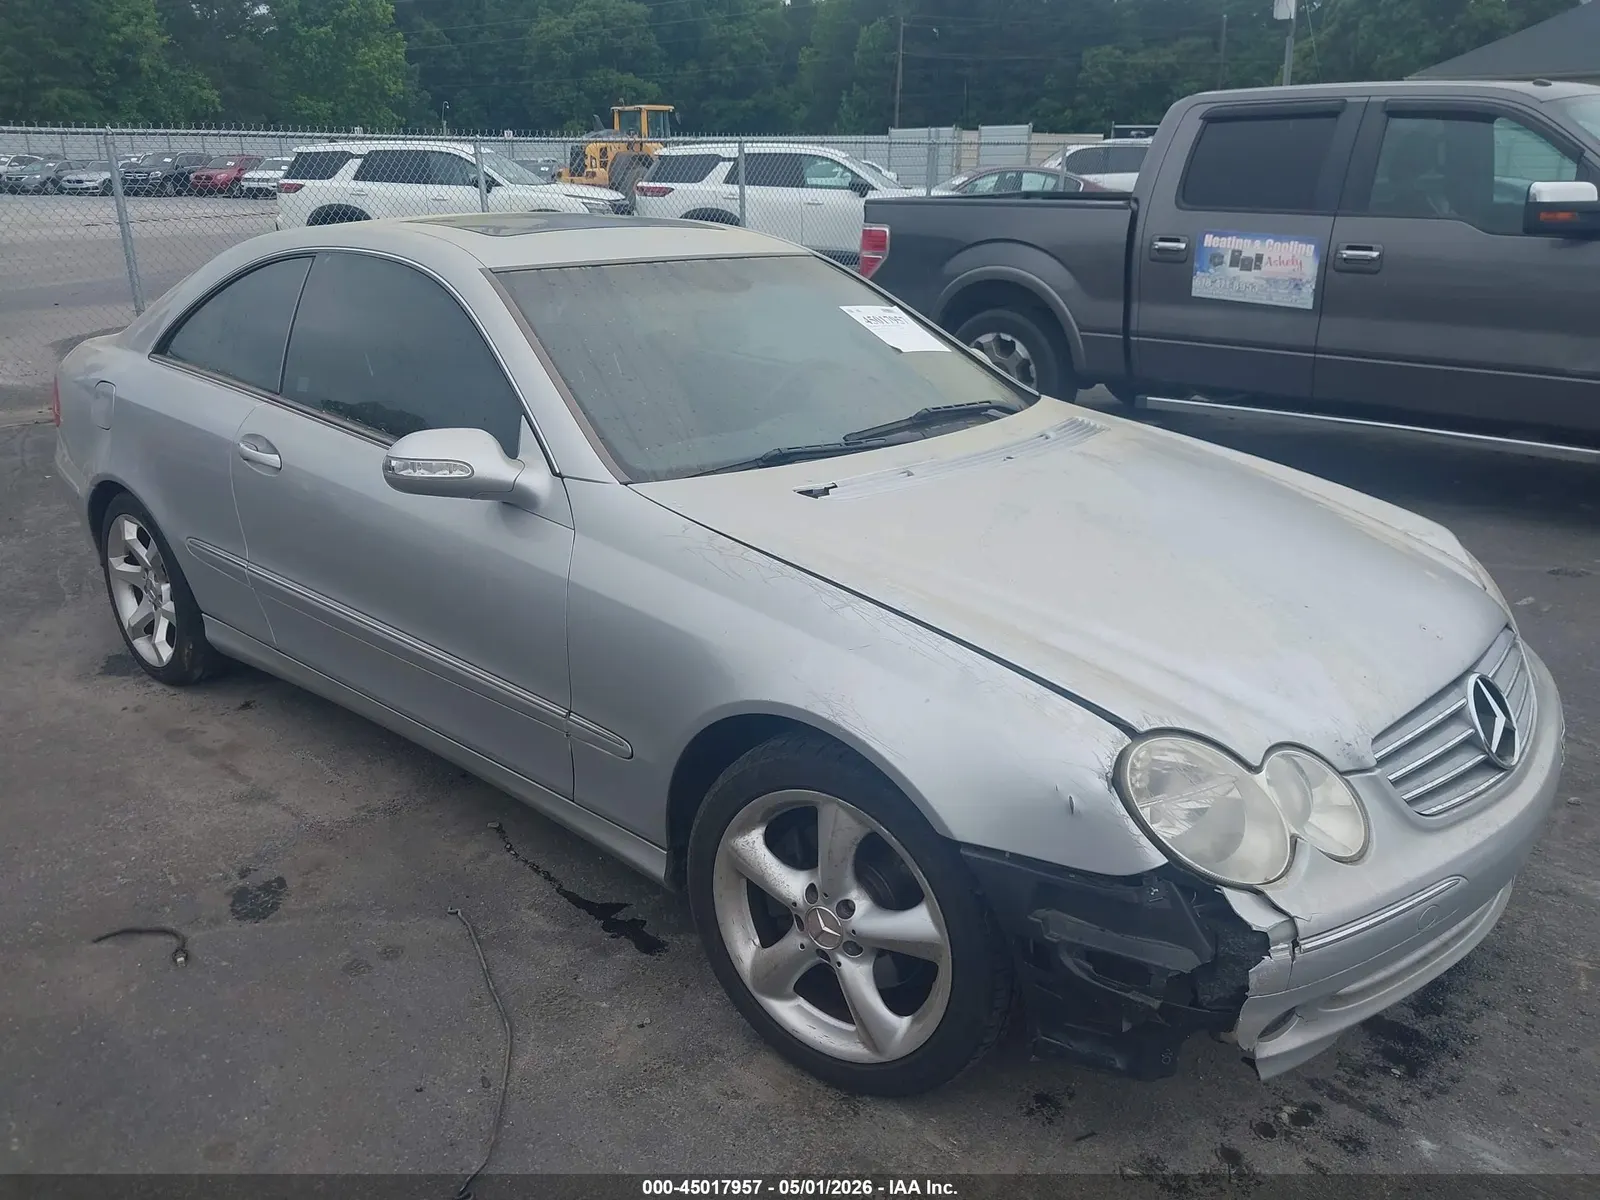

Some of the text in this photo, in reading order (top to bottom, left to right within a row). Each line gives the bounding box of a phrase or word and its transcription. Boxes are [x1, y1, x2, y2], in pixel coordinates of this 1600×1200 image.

[1204, 234, 1315, 257] Heating & Cooling
[863, 315, 909, 325] 45017957
